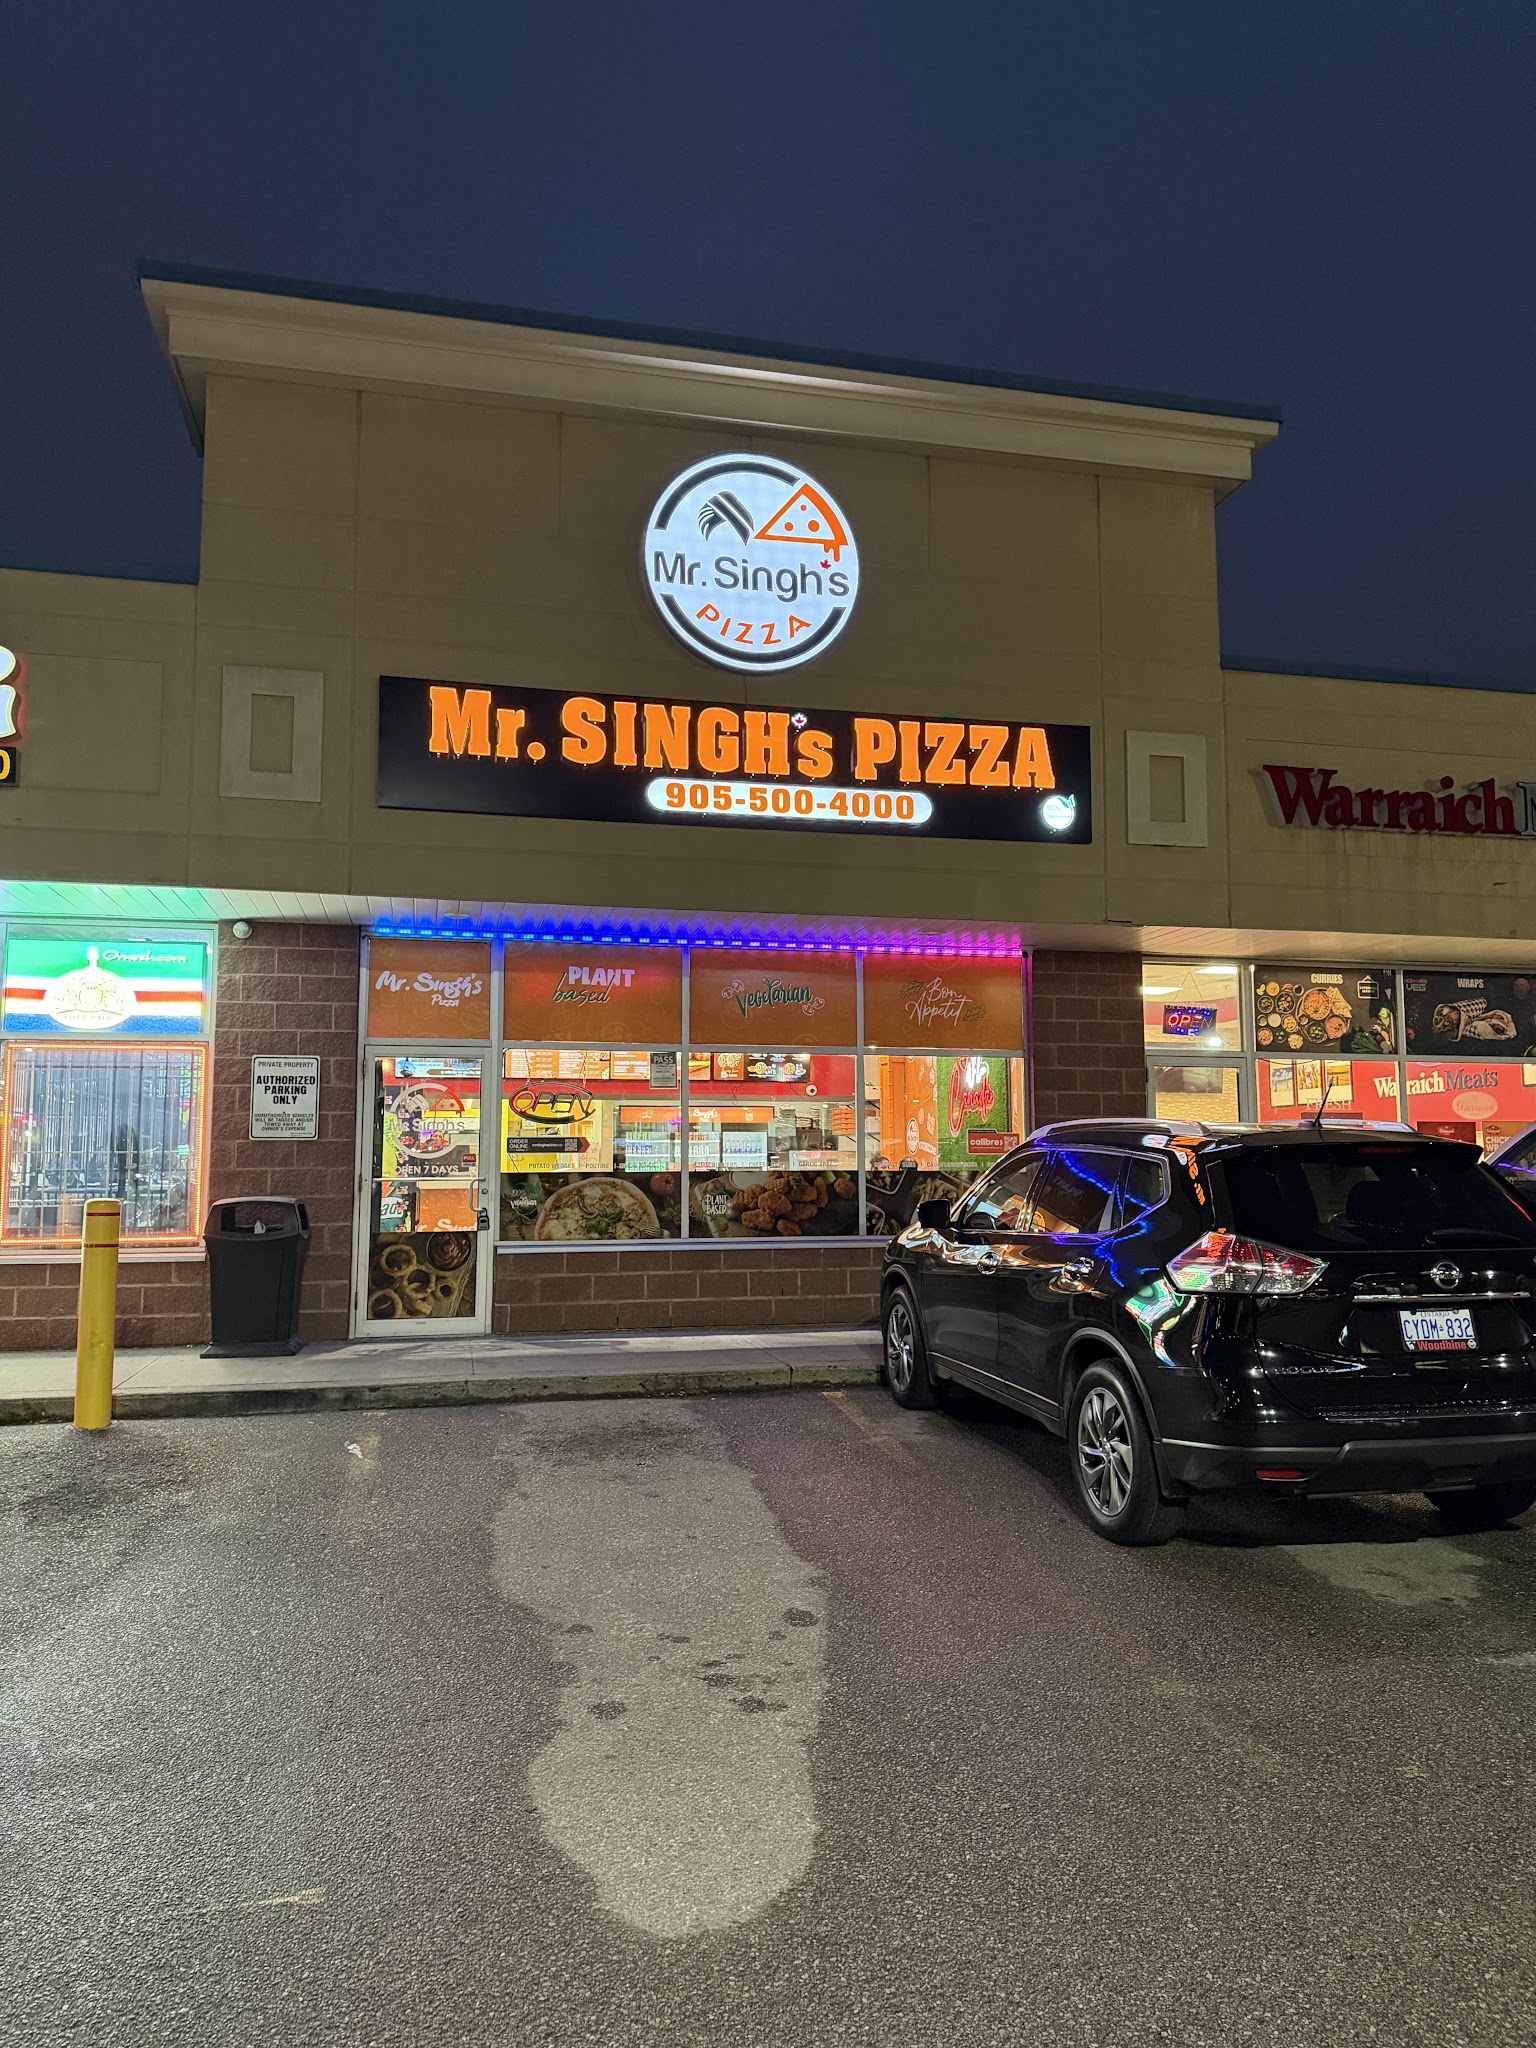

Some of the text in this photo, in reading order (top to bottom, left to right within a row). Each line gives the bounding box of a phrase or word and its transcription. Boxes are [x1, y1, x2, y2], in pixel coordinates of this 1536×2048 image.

[653, 550, 707, 586] Mr.
[695, 603, 812, 645] PIZZA
[429, 686, 546, 761] Mr.
[854, 717, 1056, 789] PIZZA
[666, 782, 915, 821] 905-500-4000
[1262, 764, 1521, 836] Warraich
[569, 966, 635, 987] PLANT
[1311, 972, 1343, 985] CURRIES
[375, 970, 482, 999] Mr. Singh's
[552, 972, 611, 1007] based
[1405, 983, 1427, 992] VEG
[1457, 978, 1484, 989] WRAPS
[926, 977, 962, 1004] Bon
[1167, 1014, 1212, 1029] OPEN
[653, 1055, 674, 1064] PASS
[256, 1075, 316, 1085] AUTHORIZED
[1373, 1068, 1498, 1099] Waraich Meats
[264, 1085, 307, 1095] PARKING
[272, 1095, 298, 1105] ONLY
[1485, 1136, 1511, 1144] CHICK
[394, 1165, 421, 1175] OPEN
[422, 1165, 430, 1174] 7
[431, 1165, 459, 1174] DAYS
[705, 1194, 727, 1204] PLANT
[705, 1204, 727, 1215] BASED
[1417, 1340, 1467, 1351] Woodbine
